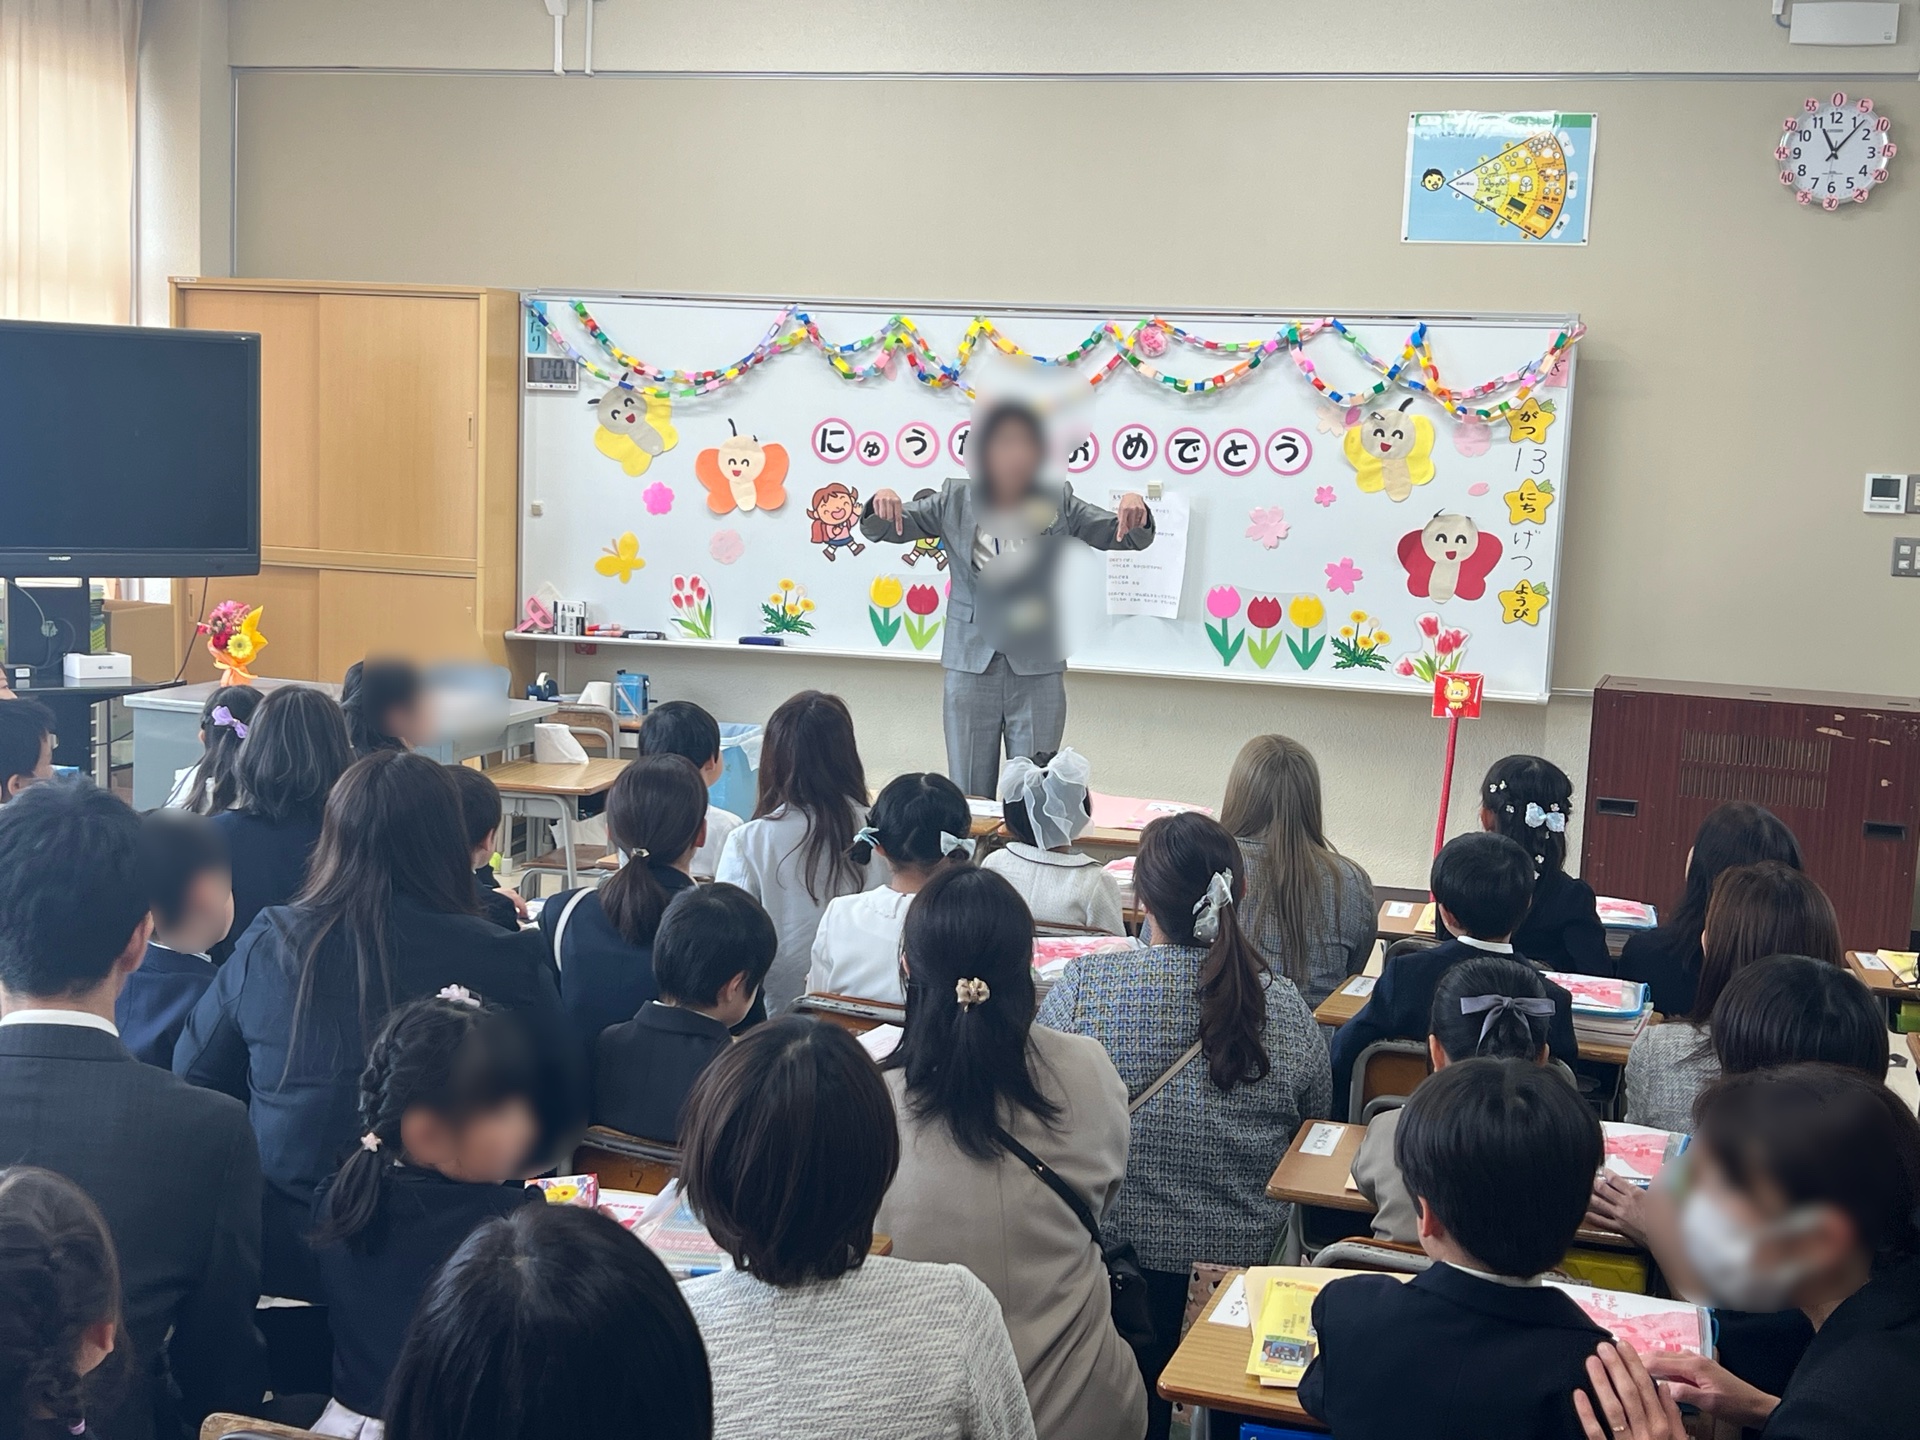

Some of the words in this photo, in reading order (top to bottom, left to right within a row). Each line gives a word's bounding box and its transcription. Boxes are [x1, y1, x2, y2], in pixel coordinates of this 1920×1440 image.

[1805, 99, 1817, 112] 55
[1833, 92, 1844, 107] 0
[1860, 99, 1870, 113] 5
[1812, 117, 1823, 129] 11
[1829, 111, 1843, 124] 12
[1784, 120, 1798, 131] 50
[1875, 119, 1889, 131] 10
[1799, 129, 1812, 142] 10
[1862, 128, 1871, 141] 2
[1775, 147, 1789, 159] 45
[1792, 147, 1802, 160] 9
[1867, 146, 1876, 159] 3
[1882, 145, 1895, 157] 15
[1781, 171, 1794, 182] 40
[1797, 164, 1807, 177] 8
[1858, 164, 1868, 177] 4
[1874, 169, 1887, 181] 20
[1811, 177, 1820, 190] 7
[1827, 182, 1836, 193] 6
[1845, 177, 1854, 189] 5
[1799, 192, 1811, 204] 35
[1854, 188, 1867, 201] 25
[1824, 198, 1838, 209] 30
[1519, 410, 1539, 435] がつ
[1515, 447, 1547, 475] 13
[1519, 492, 1537, 513] にち
[1510, 529, 1540, 571] げつ
[1512, 583, 1530, 619] ようび
[629, 1169, 644, 1188] 7
